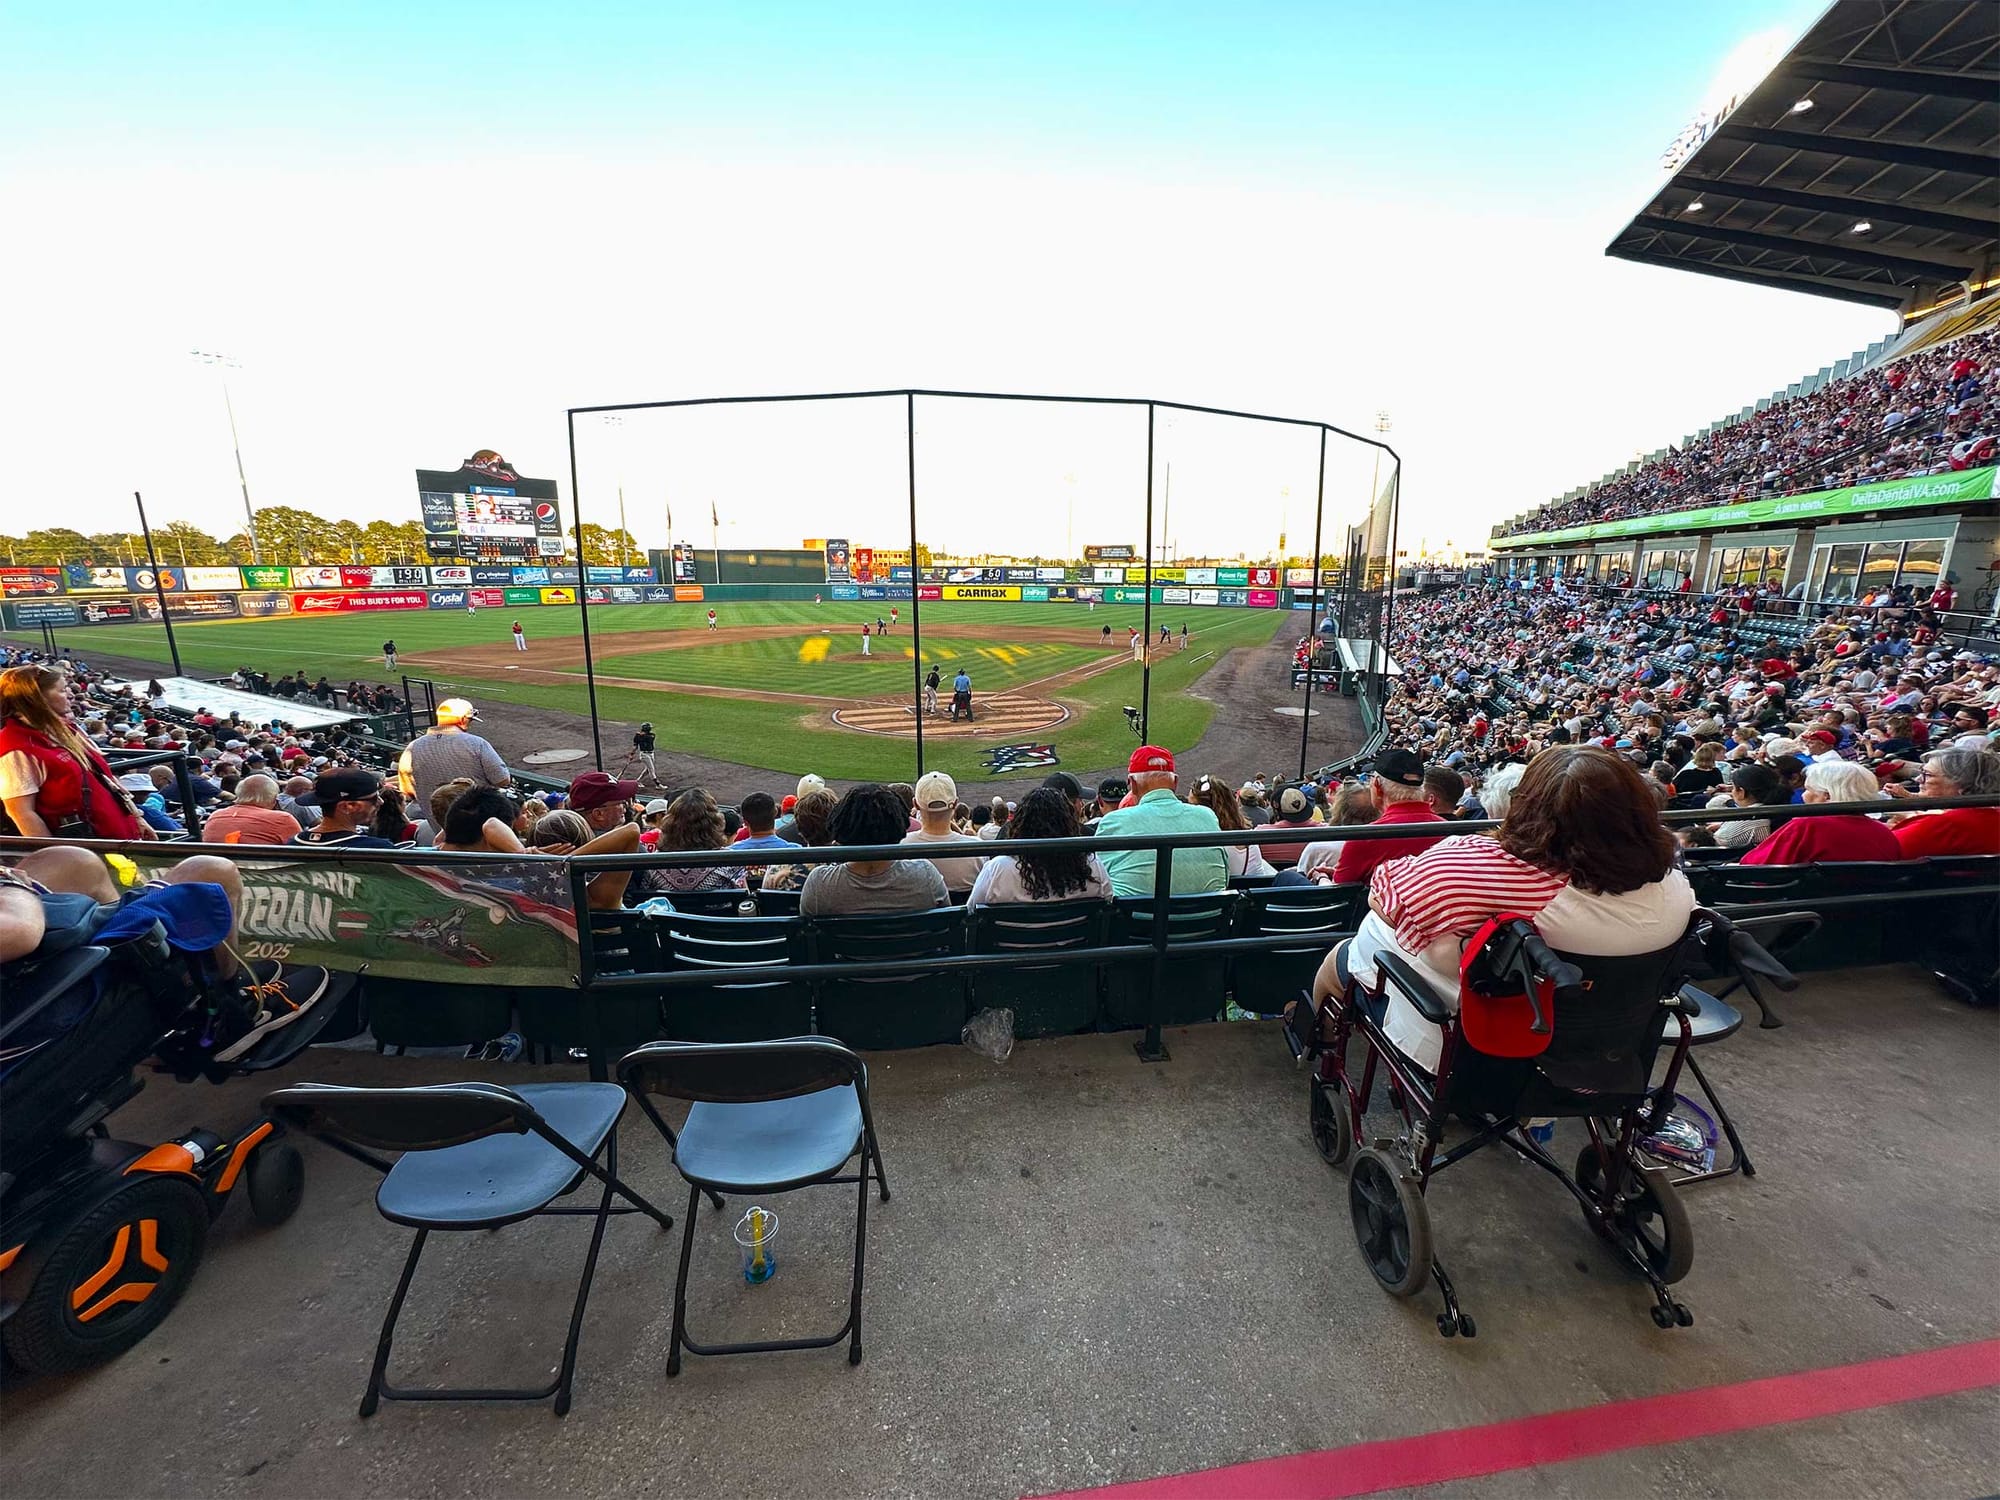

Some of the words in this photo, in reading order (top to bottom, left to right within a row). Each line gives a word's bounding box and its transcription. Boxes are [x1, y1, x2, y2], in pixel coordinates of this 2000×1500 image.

[1851, 482, 1960, 506] DeltaDentalVA.com
[159, 570, 176, 589] 6
[399, 569, 421, 579] 190
[442, 570, 466, 578] JES
[349, 598, 366, 606] THIS
[367, 597, 390, 605] BUD'S
[431, 591, 464, 605] Crystal
[244, 941, 295, 960] 2025
